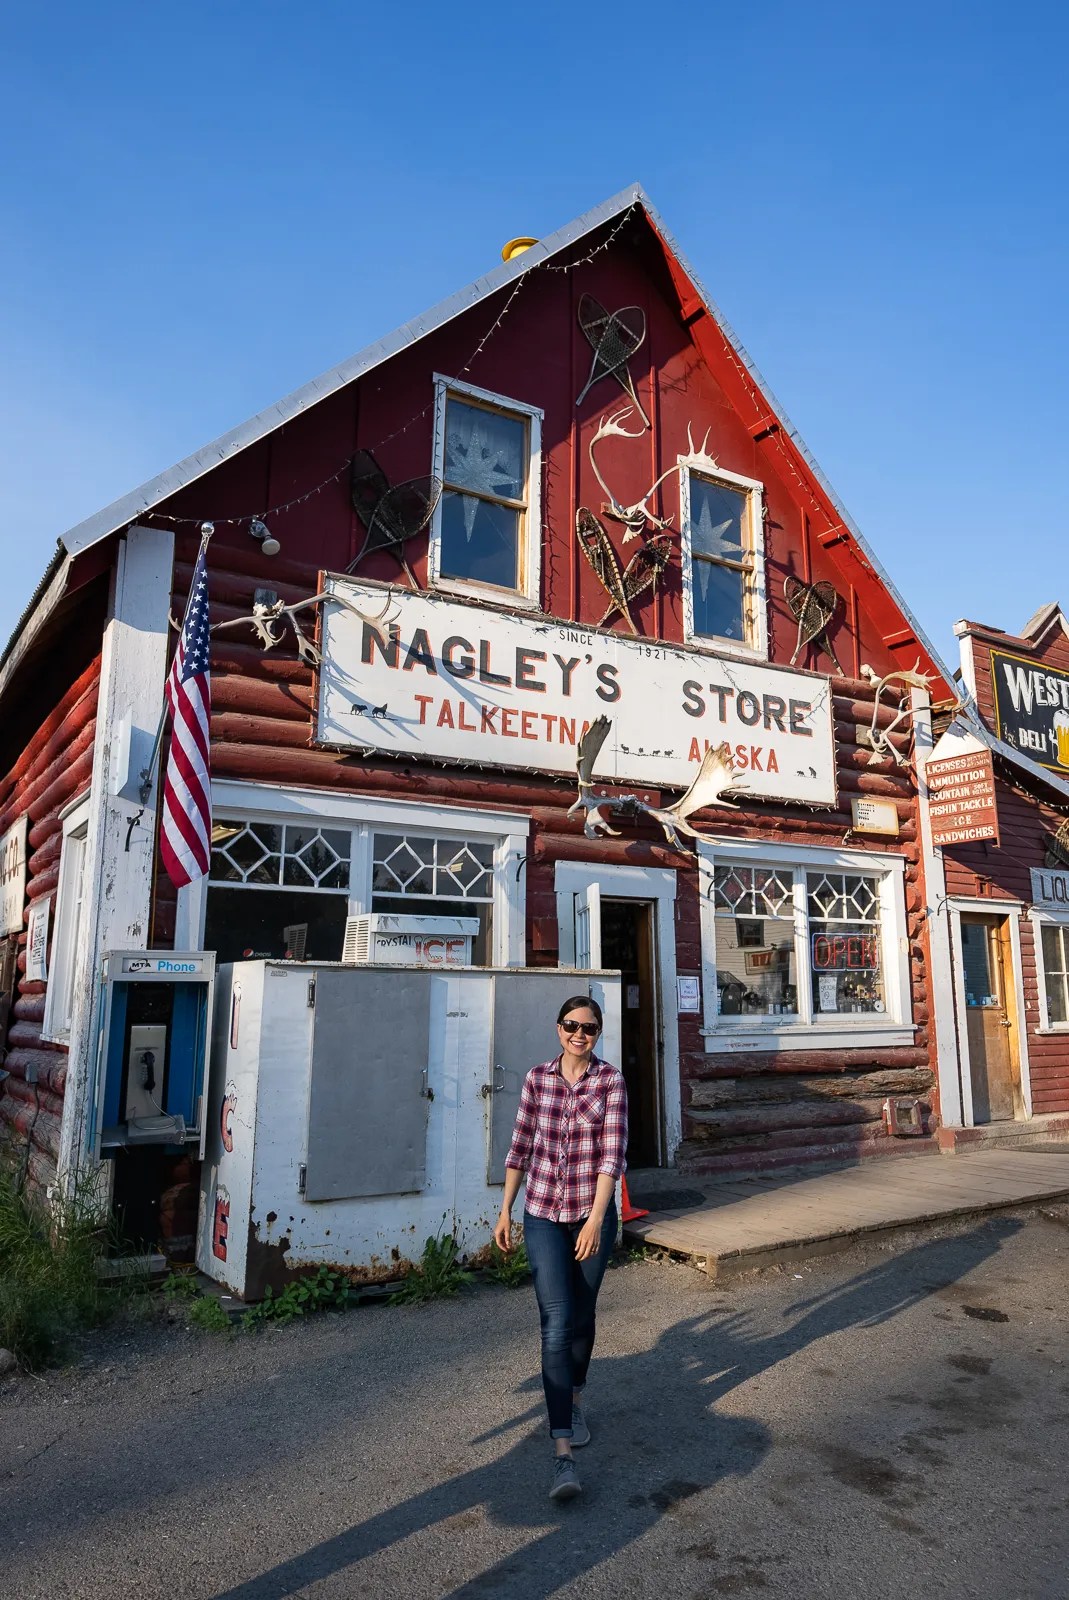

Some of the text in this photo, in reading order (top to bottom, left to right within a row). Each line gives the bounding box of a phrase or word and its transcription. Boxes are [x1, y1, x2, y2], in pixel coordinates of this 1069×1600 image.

[559, 629, 667, 661] SINCE 1921
[361, 619, 813, 737] NAGLEY'S STORE
[1019, 727, 1047, 752] DELI
[927, 758, 967, 775] LICENSES
[929, 769, 986, 789] AMMUNITION
[929, 787, 970, 802] FOUNTAIN
[959, 796, 993, 810] TACKLE
[933, 826, 994, 844] SANDWICHES
[414, 936, 465, 963] ICE
[815, 936, 877, 968] OPEN
[157, 960, 196, 972] Phone
